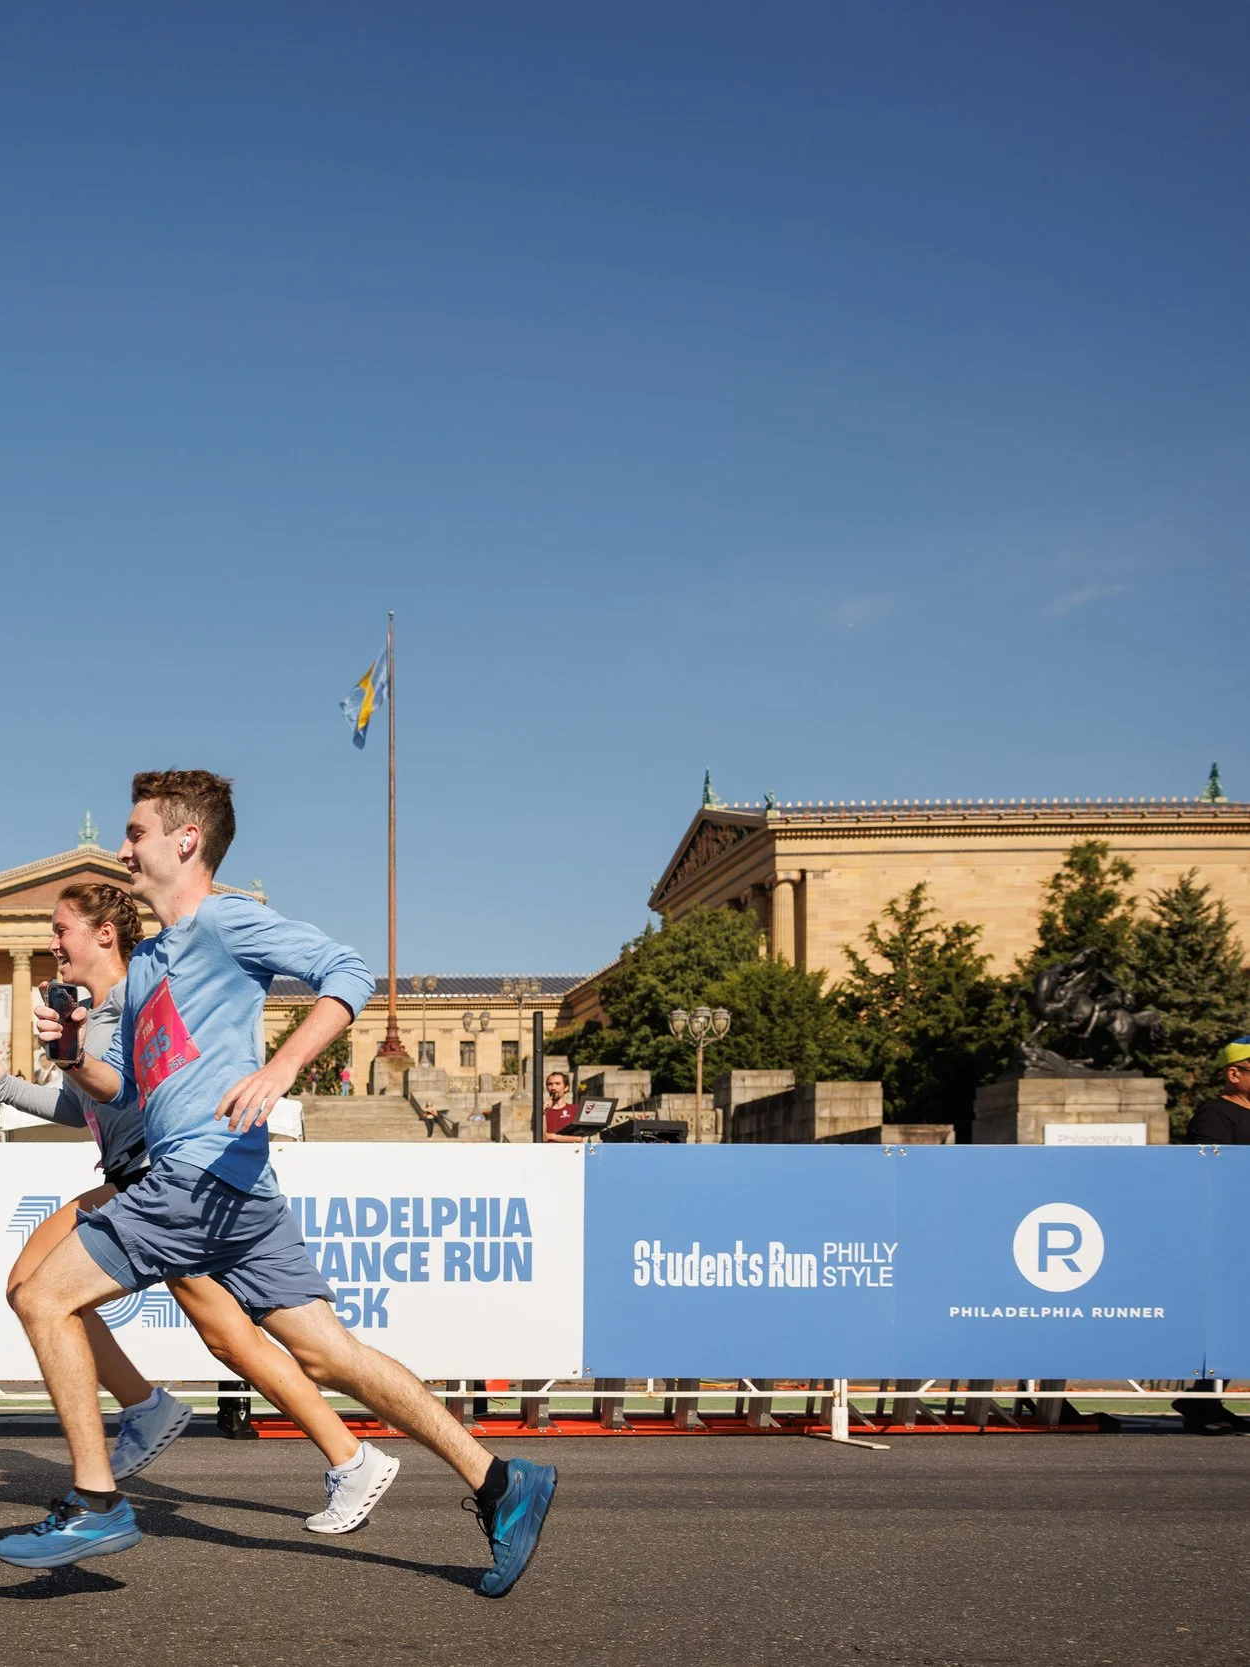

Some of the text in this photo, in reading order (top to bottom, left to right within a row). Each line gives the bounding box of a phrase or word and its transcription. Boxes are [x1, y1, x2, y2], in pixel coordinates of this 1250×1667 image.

[290, 1197, 533, 1238] ILADELPHIA
[443, 1242, 533, 1283] RUN
[633, 1239, 818, 1288] Students Run
[822, 1242, 899, 1264] PHILLY
[1037, 1222, 1083, 1273] R
[821, 1266, 894, 1288] STYLE
[335, 1287, 391, 1329] 5K
[949, 1306, 1165, 1318] PHILADELPHIA RUNNER
